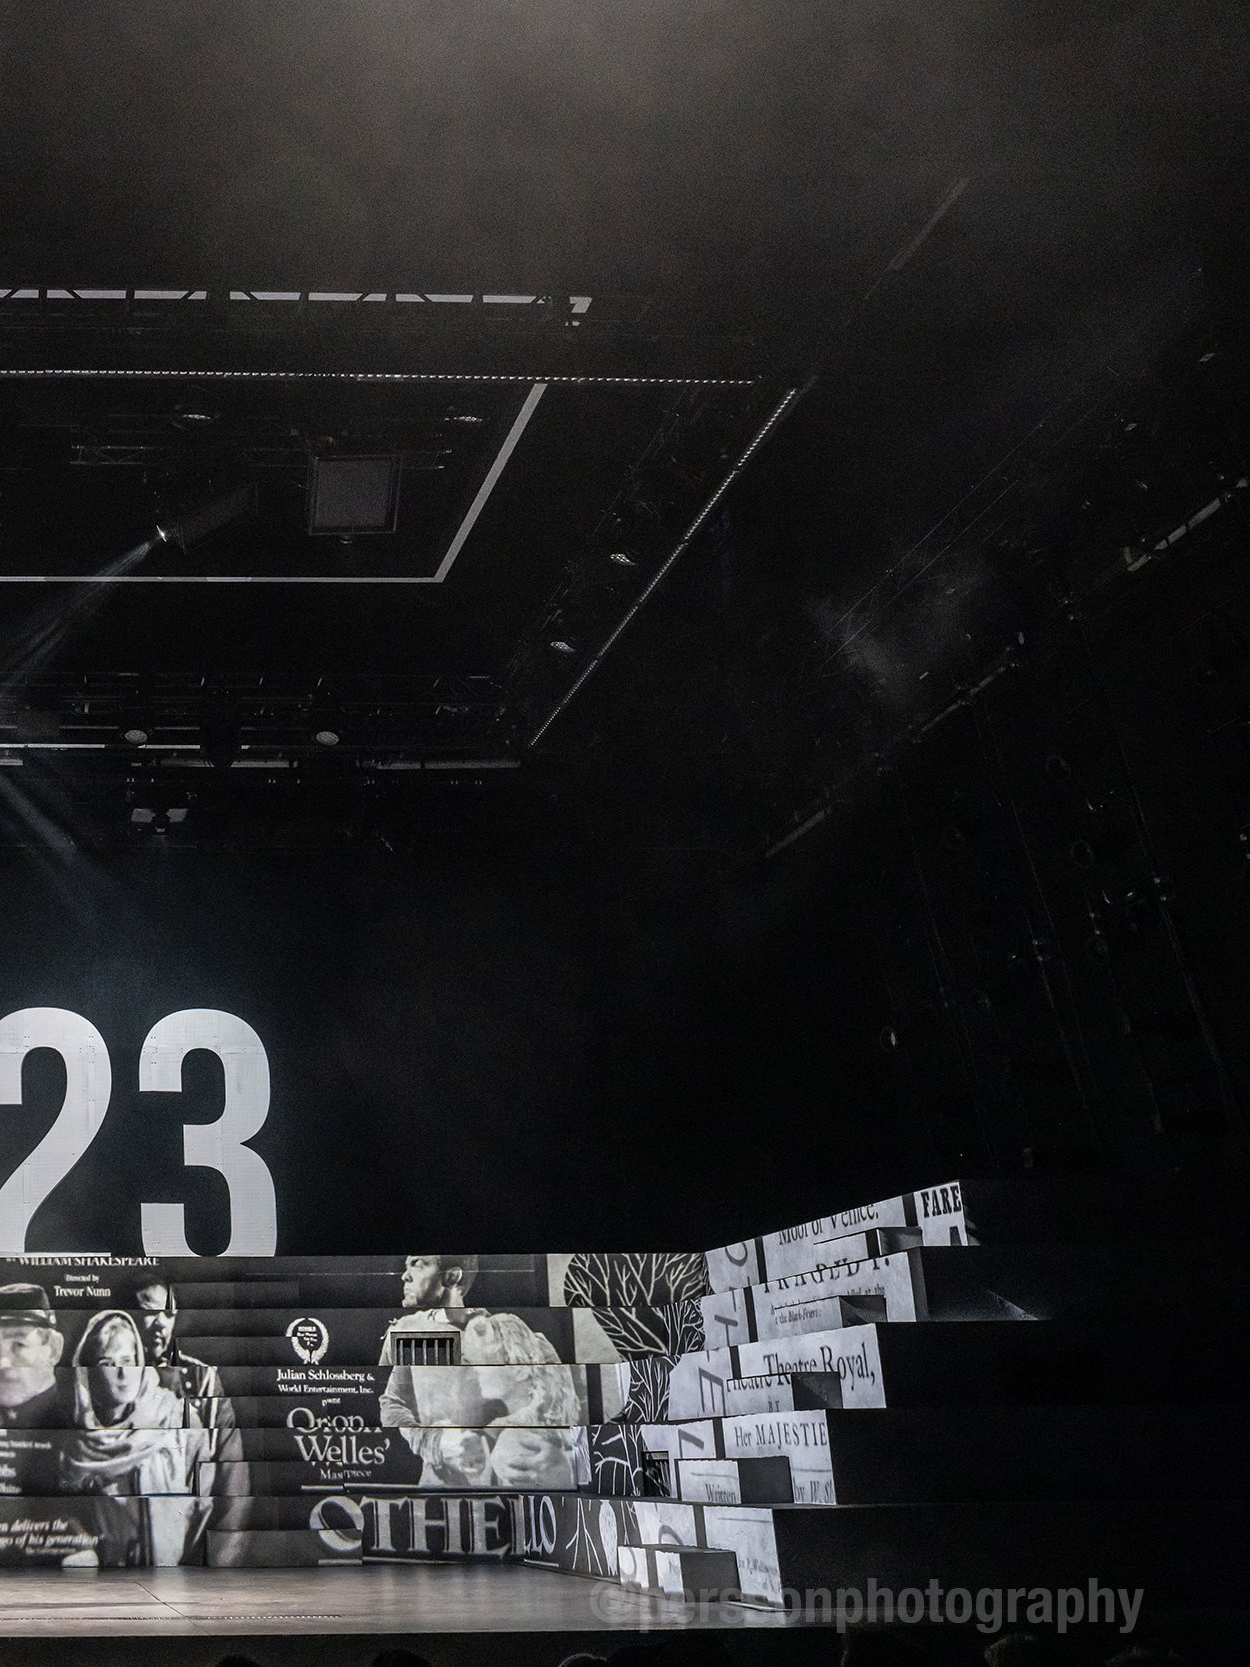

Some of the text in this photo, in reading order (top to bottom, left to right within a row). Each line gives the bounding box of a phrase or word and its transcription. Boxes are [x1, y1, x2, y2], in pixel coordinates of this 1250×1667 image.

[920, 1185, 961, 1218] FARE
[54, 1285, 111, 1297] Trevor Nunn
[276, 1368, 376, 1383] Julian Schlossberg &
[278, 1384, 302, 1393] World
[359, 1385, 374, 1394] Inc.
[734, 1426, 752, 1448] Her
